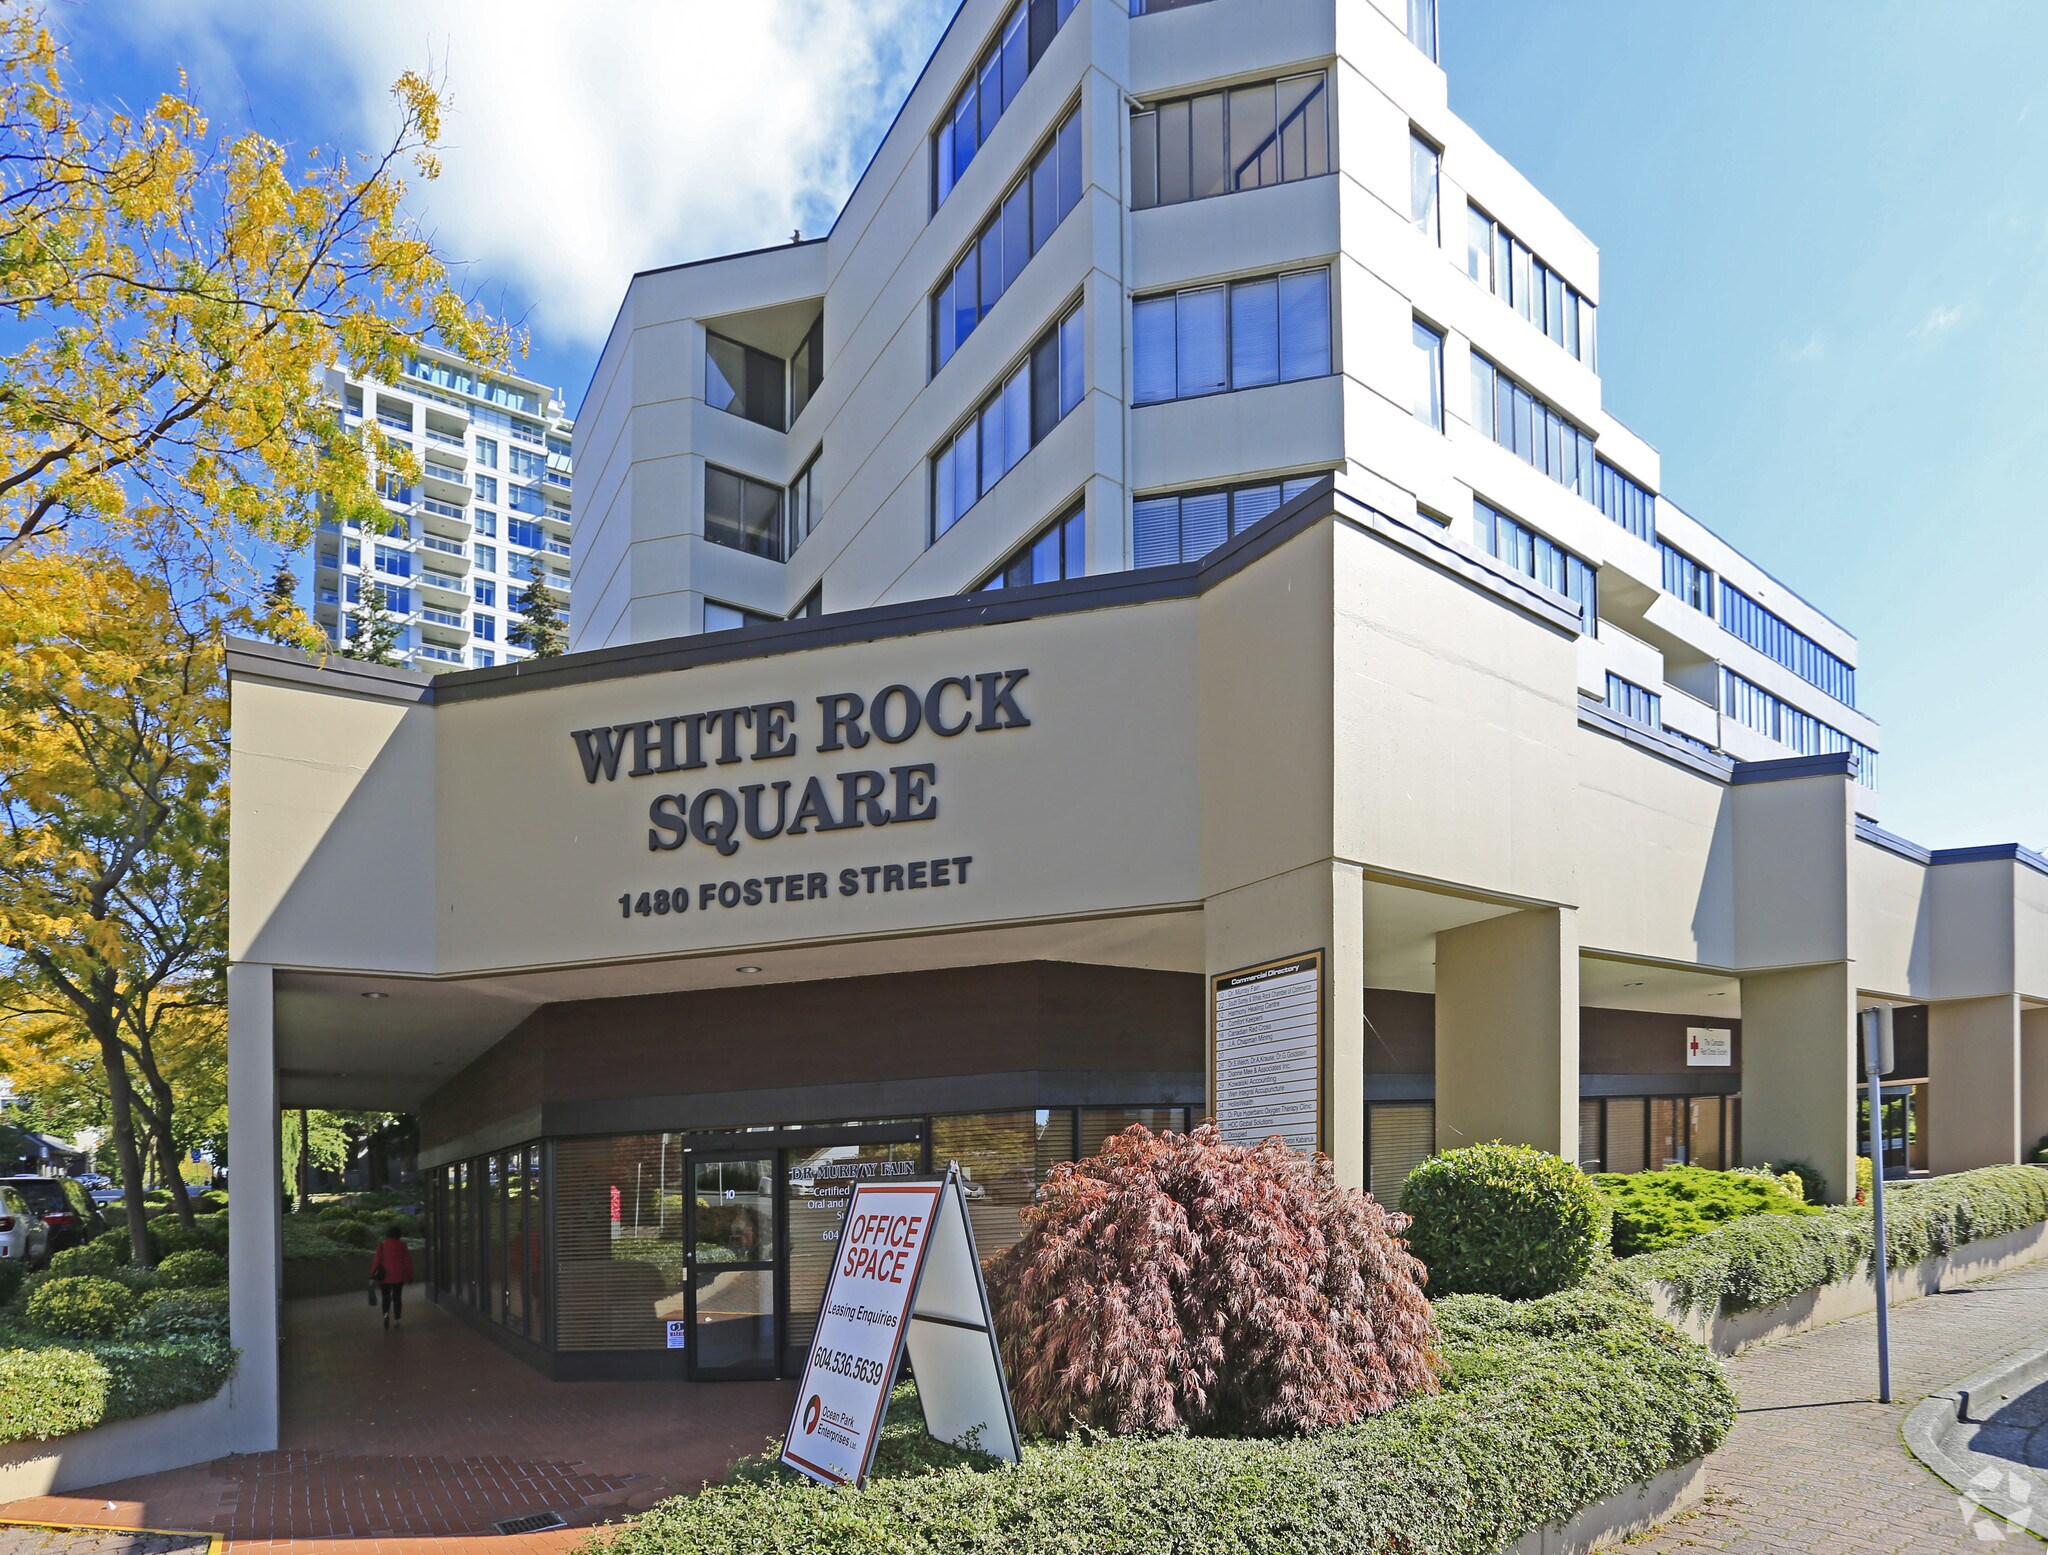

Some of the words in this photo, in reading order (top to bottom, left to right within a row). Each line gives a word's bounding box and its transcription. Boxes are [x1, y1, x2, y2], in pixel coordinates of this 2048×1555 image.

[571, 700, 796, 783] WHITE
[816, 668, 1031, 752] ROCK
[649, 762, 937, 856] SQUARE
[618, 887, 689, 918] 1480
[699, 872, 827, 910] FOSTER
[840, 856, 972, 897] STREET
[1232, 971, 1267, 985] Commercial
[1268, 965, 1299, 976] Directory
[1235, 987, 1249, 996] Murray
[1272, 989, 1287, 997] Chamber
[1292, 984, 1311, 992] Commerce
[1228, 1007, 1247, 1017] Harmony
[1248, 1003, 1264, 1012] Healing
[1228, 1019, 1244, 1027] Comfort
[1246, 1015, 1263, 1024] Keepers
[1228, 1028, 1248, 1037] Canadian
[1237, 1036, 1257, 1046] Chapman
[1258, 1064, 1281, 1073] Associates
[1228, 1079, 1248, 1087] Kowalski
[1250, 1076, 1276, 1085] Accounting
[1239, 1088, 1254, 1097] Integral
[1243, 1107, 1264, 1118] Hyperbaric
[1265, 1107, 1280, 1115] Oxygen
[1228, 1131, 1247, 1139] Occupied
[791, 1167, 813, 1180] DR
[816, 1163, 877, 1179] MURRAY
[881, 1161, 915, 1176] FAIN
[724, 1189, 735, 1200] 10
[814, 1186, 850, 1196] Certified
[807, 1199, 824, 1209] Oral
[828, 1199, 843, 1208] and
[823, 1231, 839, 1240] 604
[851, 1215, 922, 1248] OFFICE
[843, 1247, 909, 1283] SPACE
[828, 1301, 855, 1322] Leasing
[857, 1305, 897, 1327] Enquiries
[814, 1346, 883, 1385] 604.536.5639
[822, 1406, 839, 1422] Ocean
[840, 1412, 854, 1428] Park
[817, 1423, 850, 1447] Enterprises
